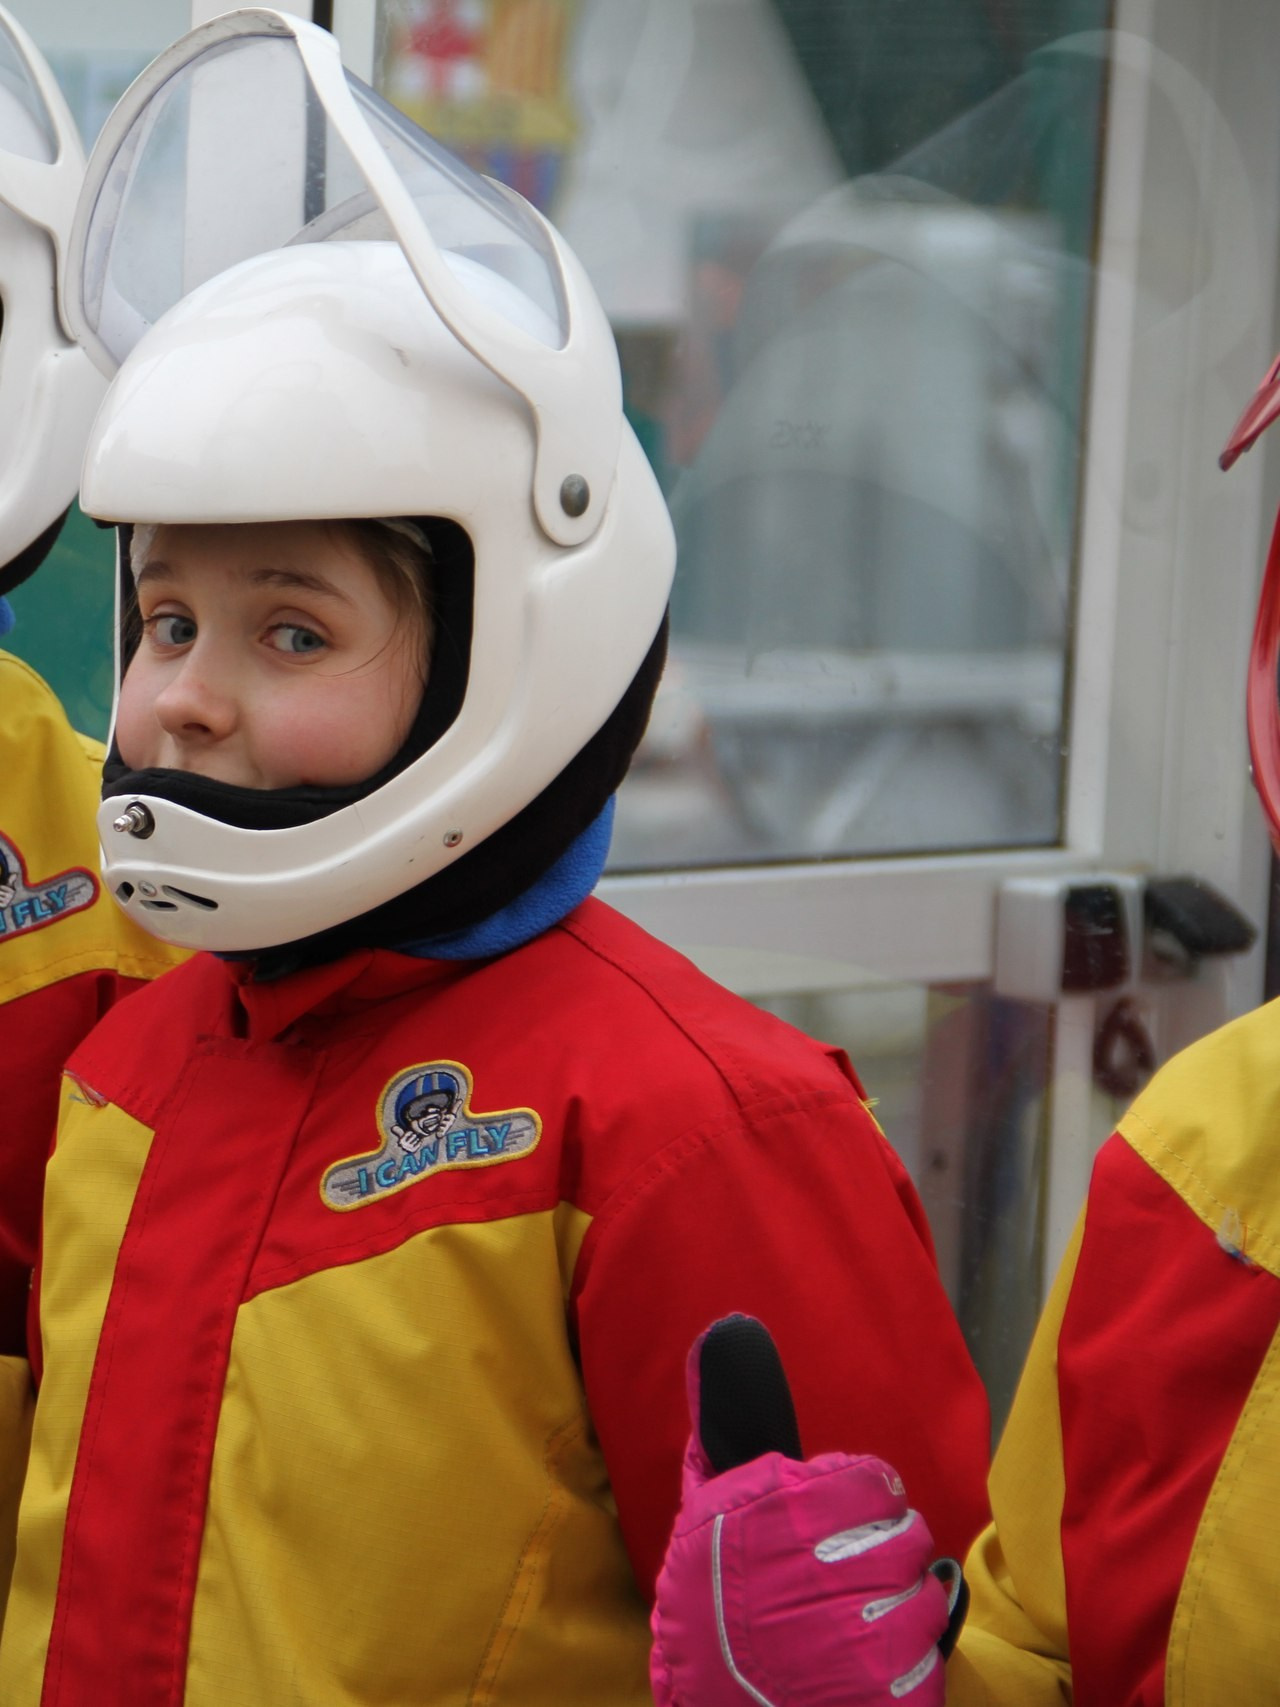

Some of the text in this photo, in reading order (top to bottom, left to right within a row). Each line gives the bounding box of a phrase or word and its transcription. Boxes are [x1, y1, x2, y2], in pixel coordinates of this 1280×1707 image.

[11, 884, 69, 927] FLY
[357, 1122, 512, 1195] I CAN FLY
